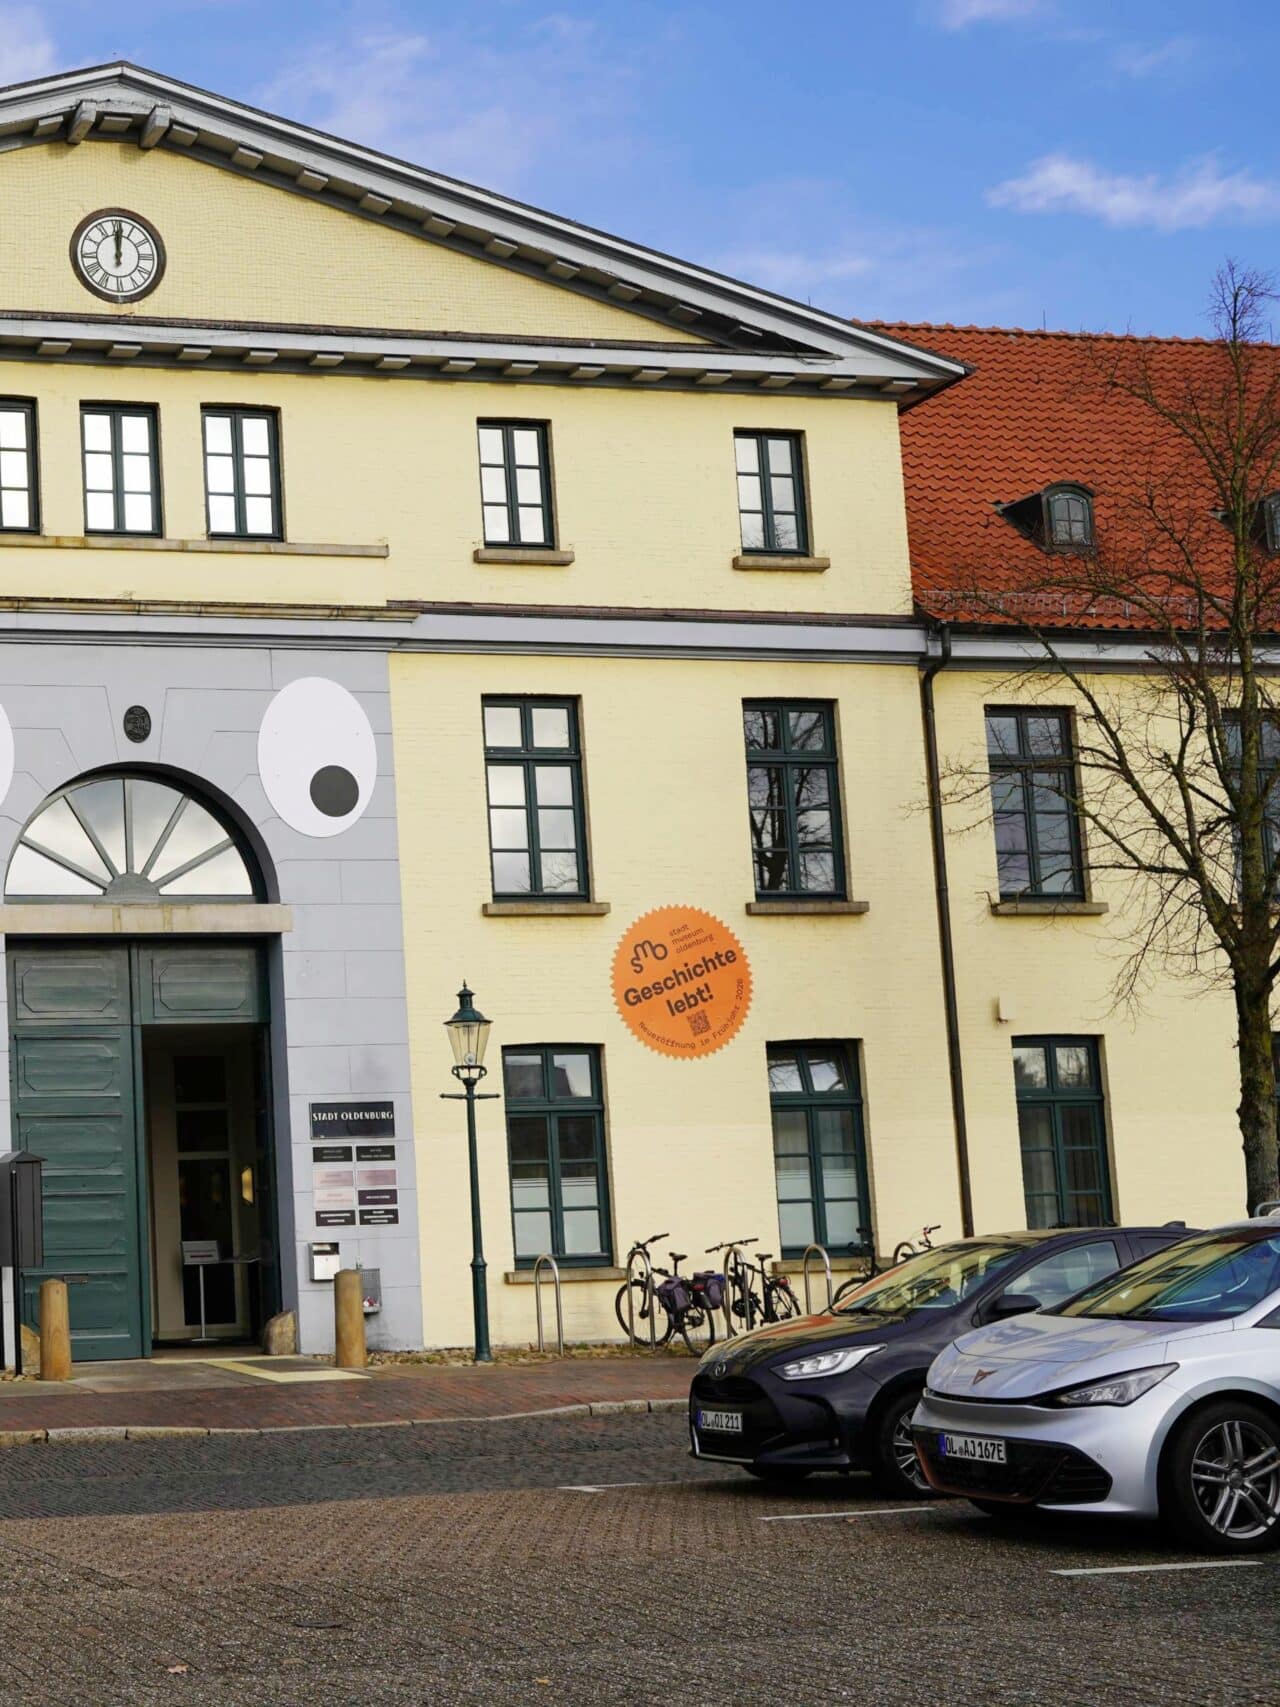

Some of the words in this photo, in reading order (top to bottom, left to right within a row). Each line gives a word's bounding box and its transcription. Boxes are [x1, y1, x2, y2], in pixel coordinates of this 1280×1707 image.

[669, 924, 690, 937] stadt
[672, 927, 704, 945] museum
[676, 933, 714, 954] oldenburg
[624, 949, 737, 1007] Geschichte
[666, 983, 714, 1017] lebt!
[312, 1112, 338, 1121] STADT
[341, 1110, 393, 1121] OLDENBURG
[725, 1414, 739, 1429] 211
[945, 1437, 957, 1454] OL
[964, 1439, 976, 1458] AJ
[978, 1441, 1005, 1461] 167E
